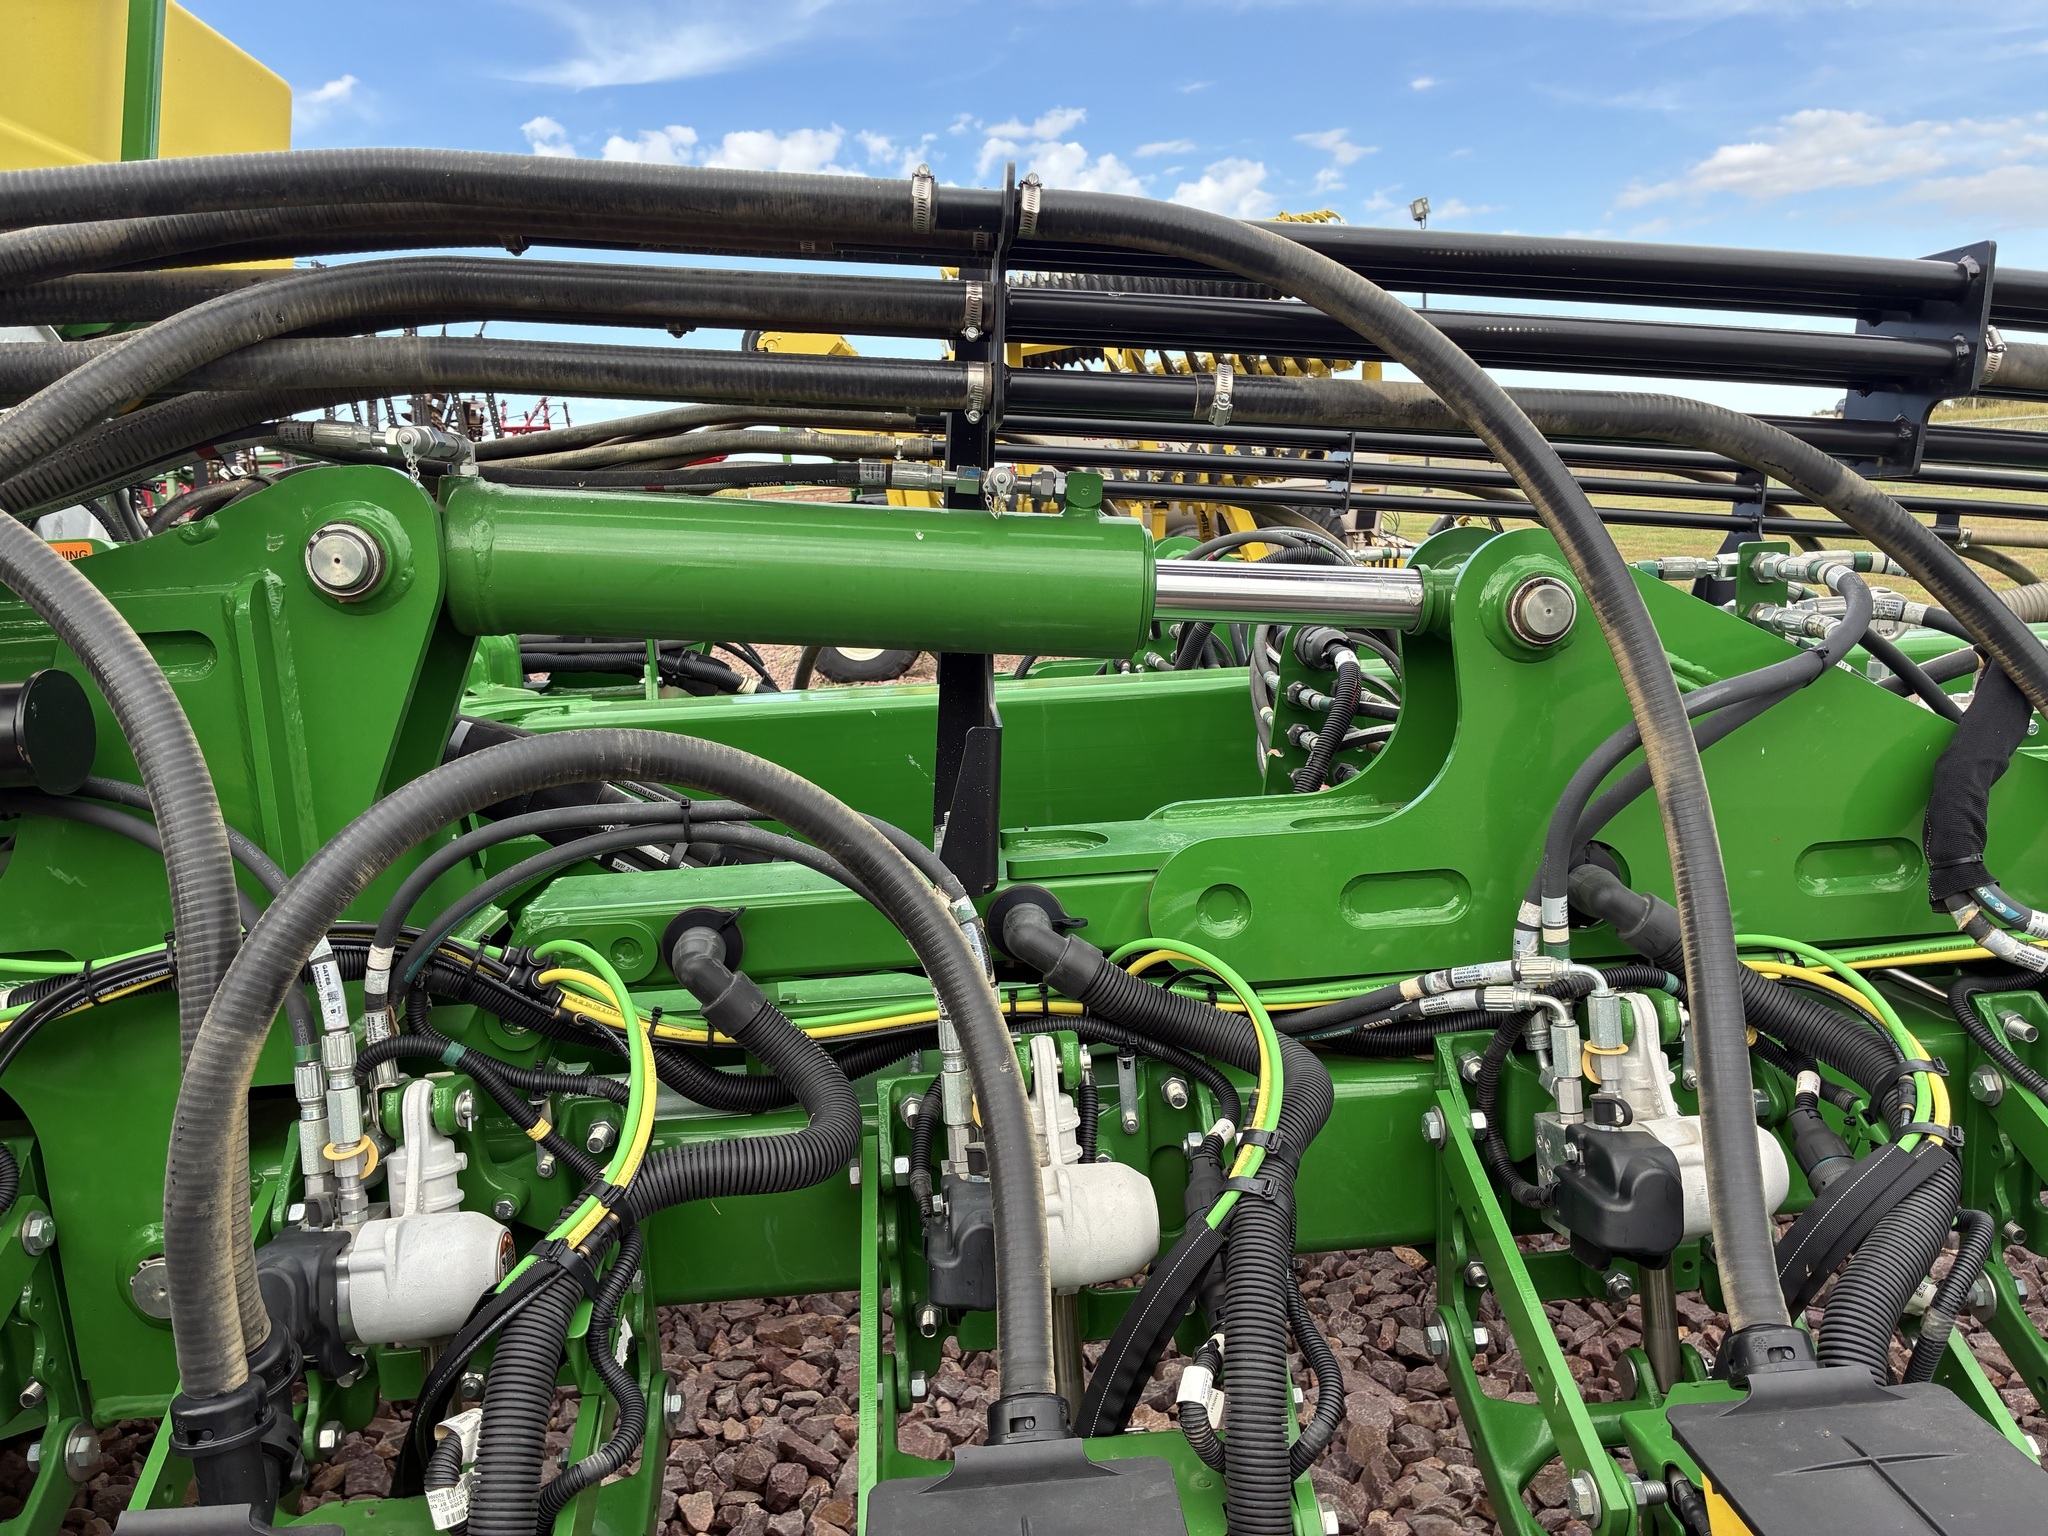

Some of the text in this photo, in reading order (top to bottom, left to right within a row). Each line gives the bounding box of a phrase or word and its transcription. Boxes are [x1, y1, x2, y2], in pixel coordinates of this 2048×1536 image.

[107, 474, 143, 490] RESISTANT
[230, 833, 286, 888] USA Made in Mexi
[322, 964, 332, 986] GATES
[1363, 1018, 1392, 1029] GATES
